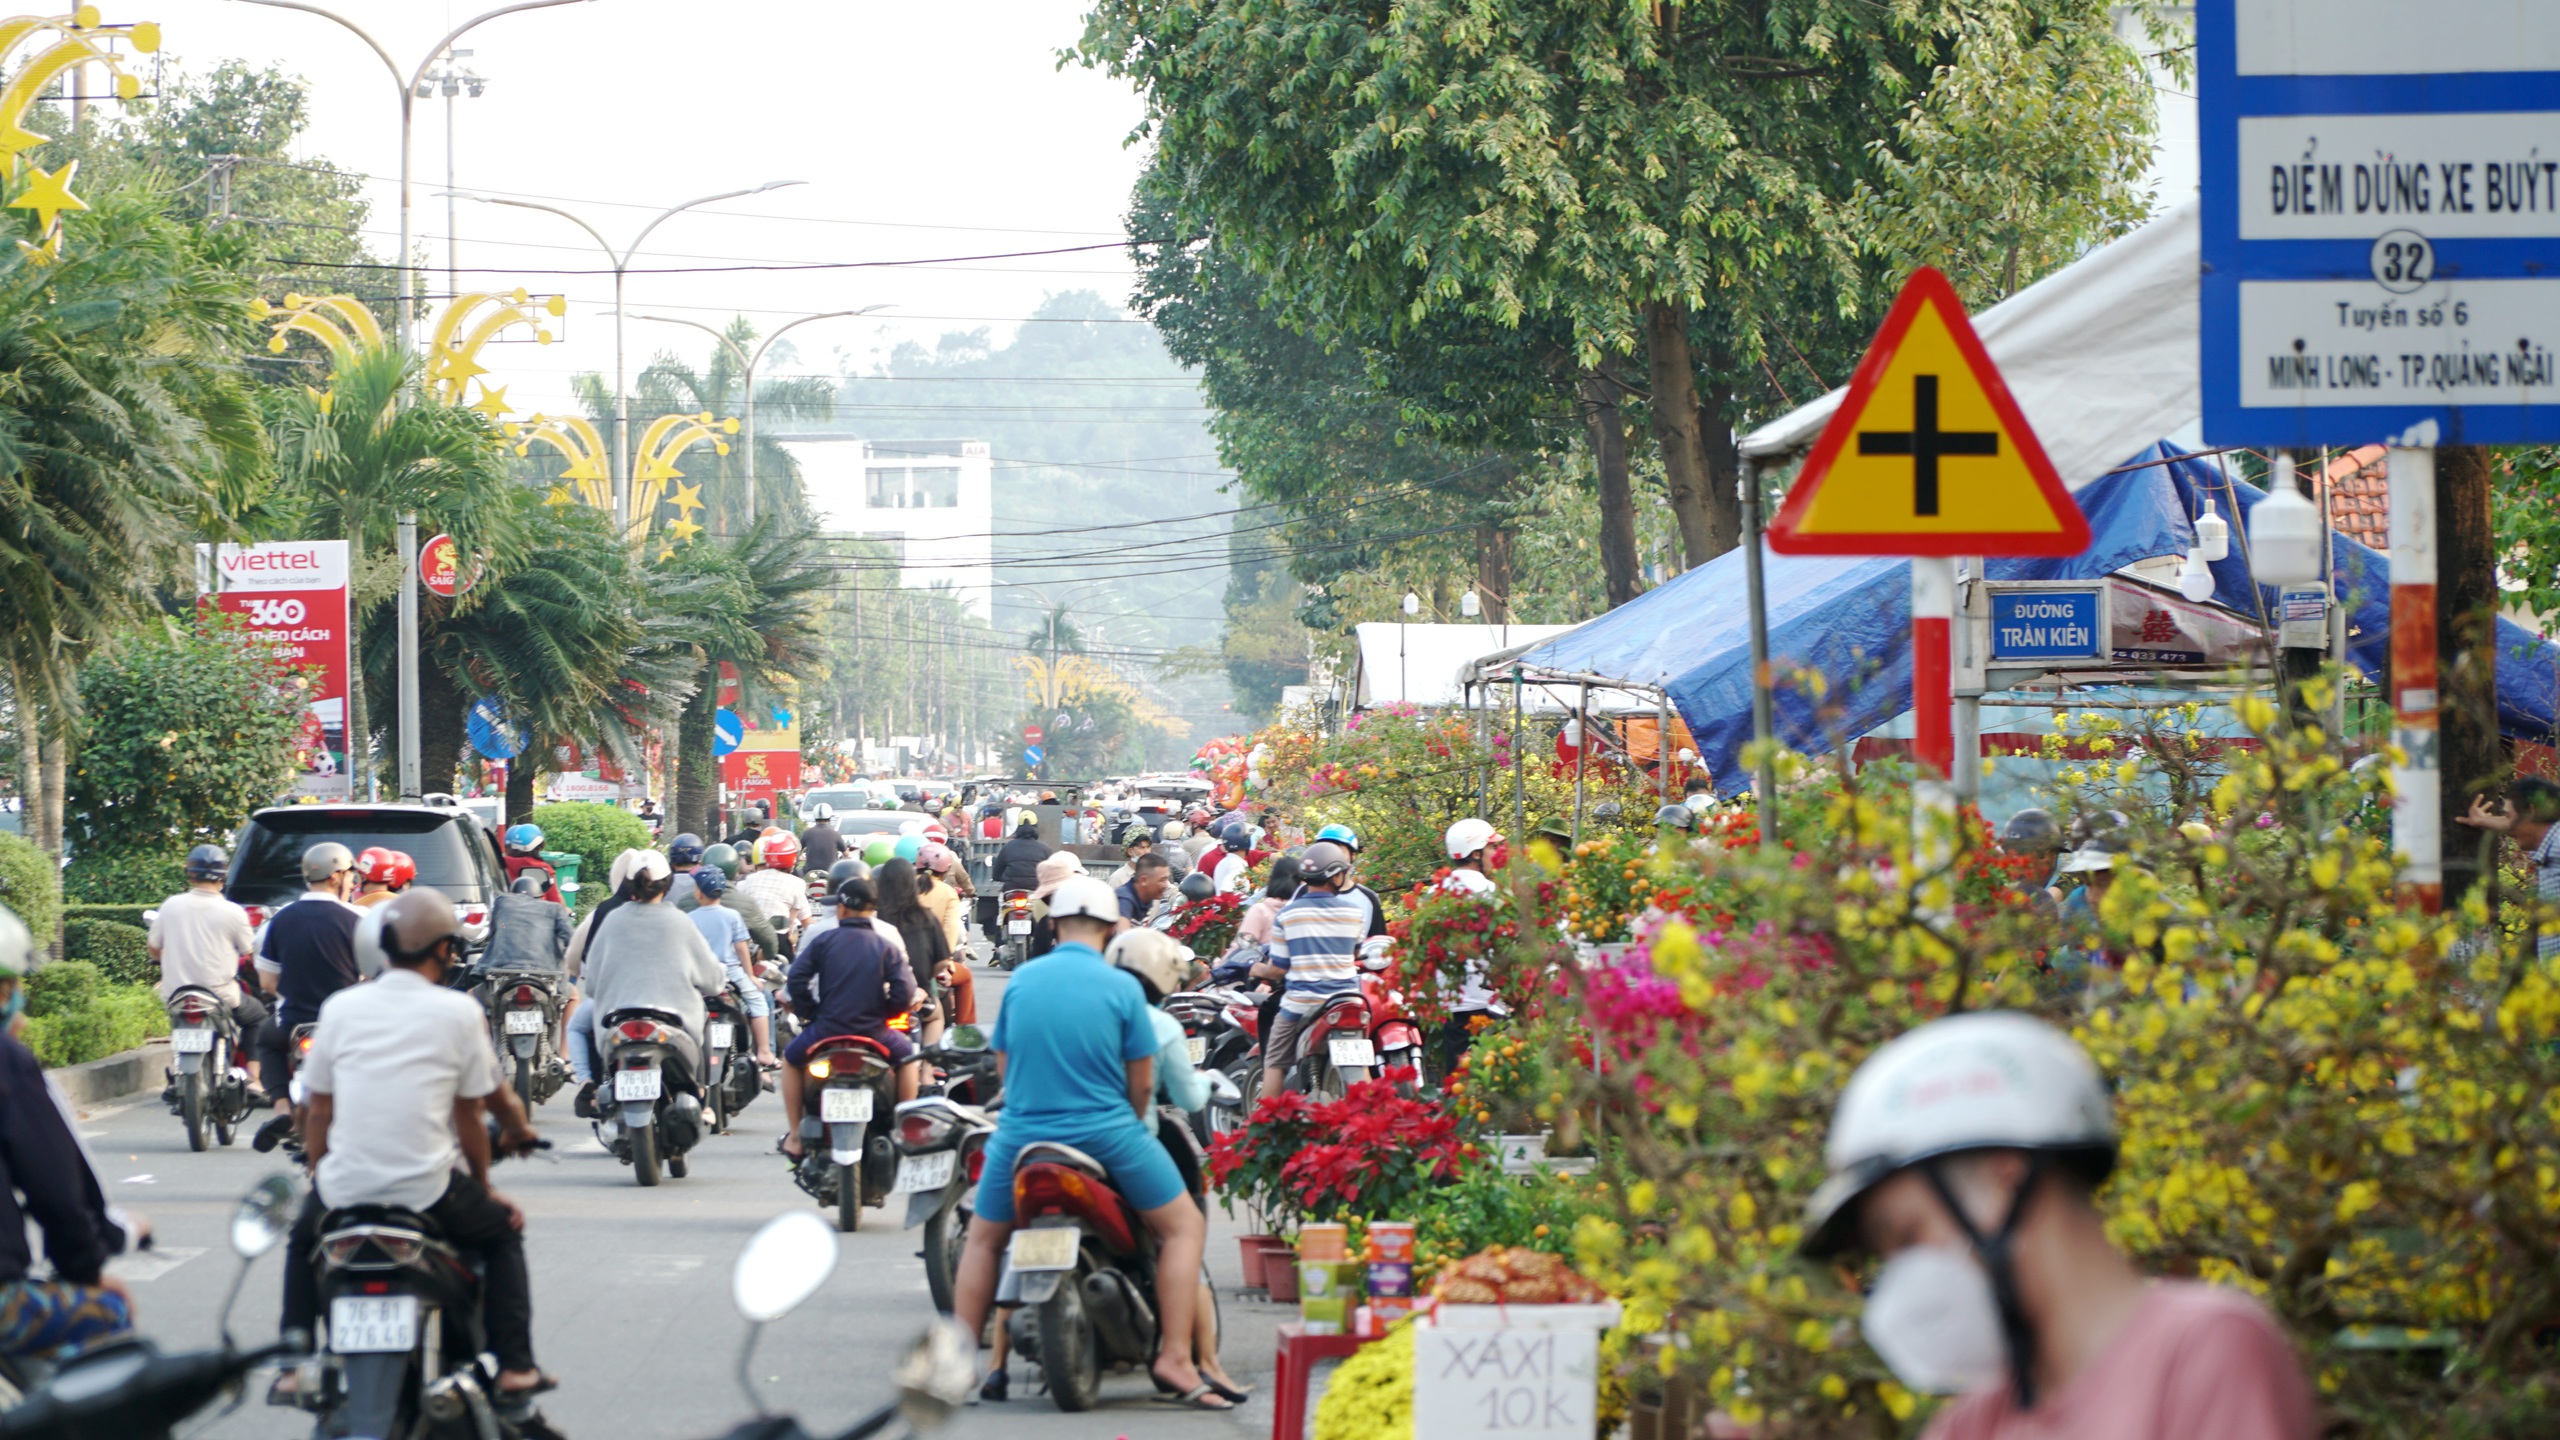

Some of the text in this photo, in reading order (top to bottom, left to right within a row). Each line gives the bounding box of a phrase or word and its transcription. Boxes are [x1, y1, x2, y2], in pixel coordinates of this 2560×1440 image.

[2271, 136, 2558, 215] ĐIỂM DỪNG XE BUÝT
[2384, 242, 2425, 282] 32
[2336, 299, 2469, 331] Tuyến số 6
[2269, 355, 2320, 389] MINH
[2327, 355, 2380, 389] LONG
[966, 446, 986, 456] AIA
[222, 550, 321, 571] viettel
[2015, 600, 2075, 619] ĐƯỜNG
[290, 627, 331, 641] CÁCH
[2001, 622, 2089, 647] TRẦN KIÊN
[339, 1325, 408, 1347] 276.46
